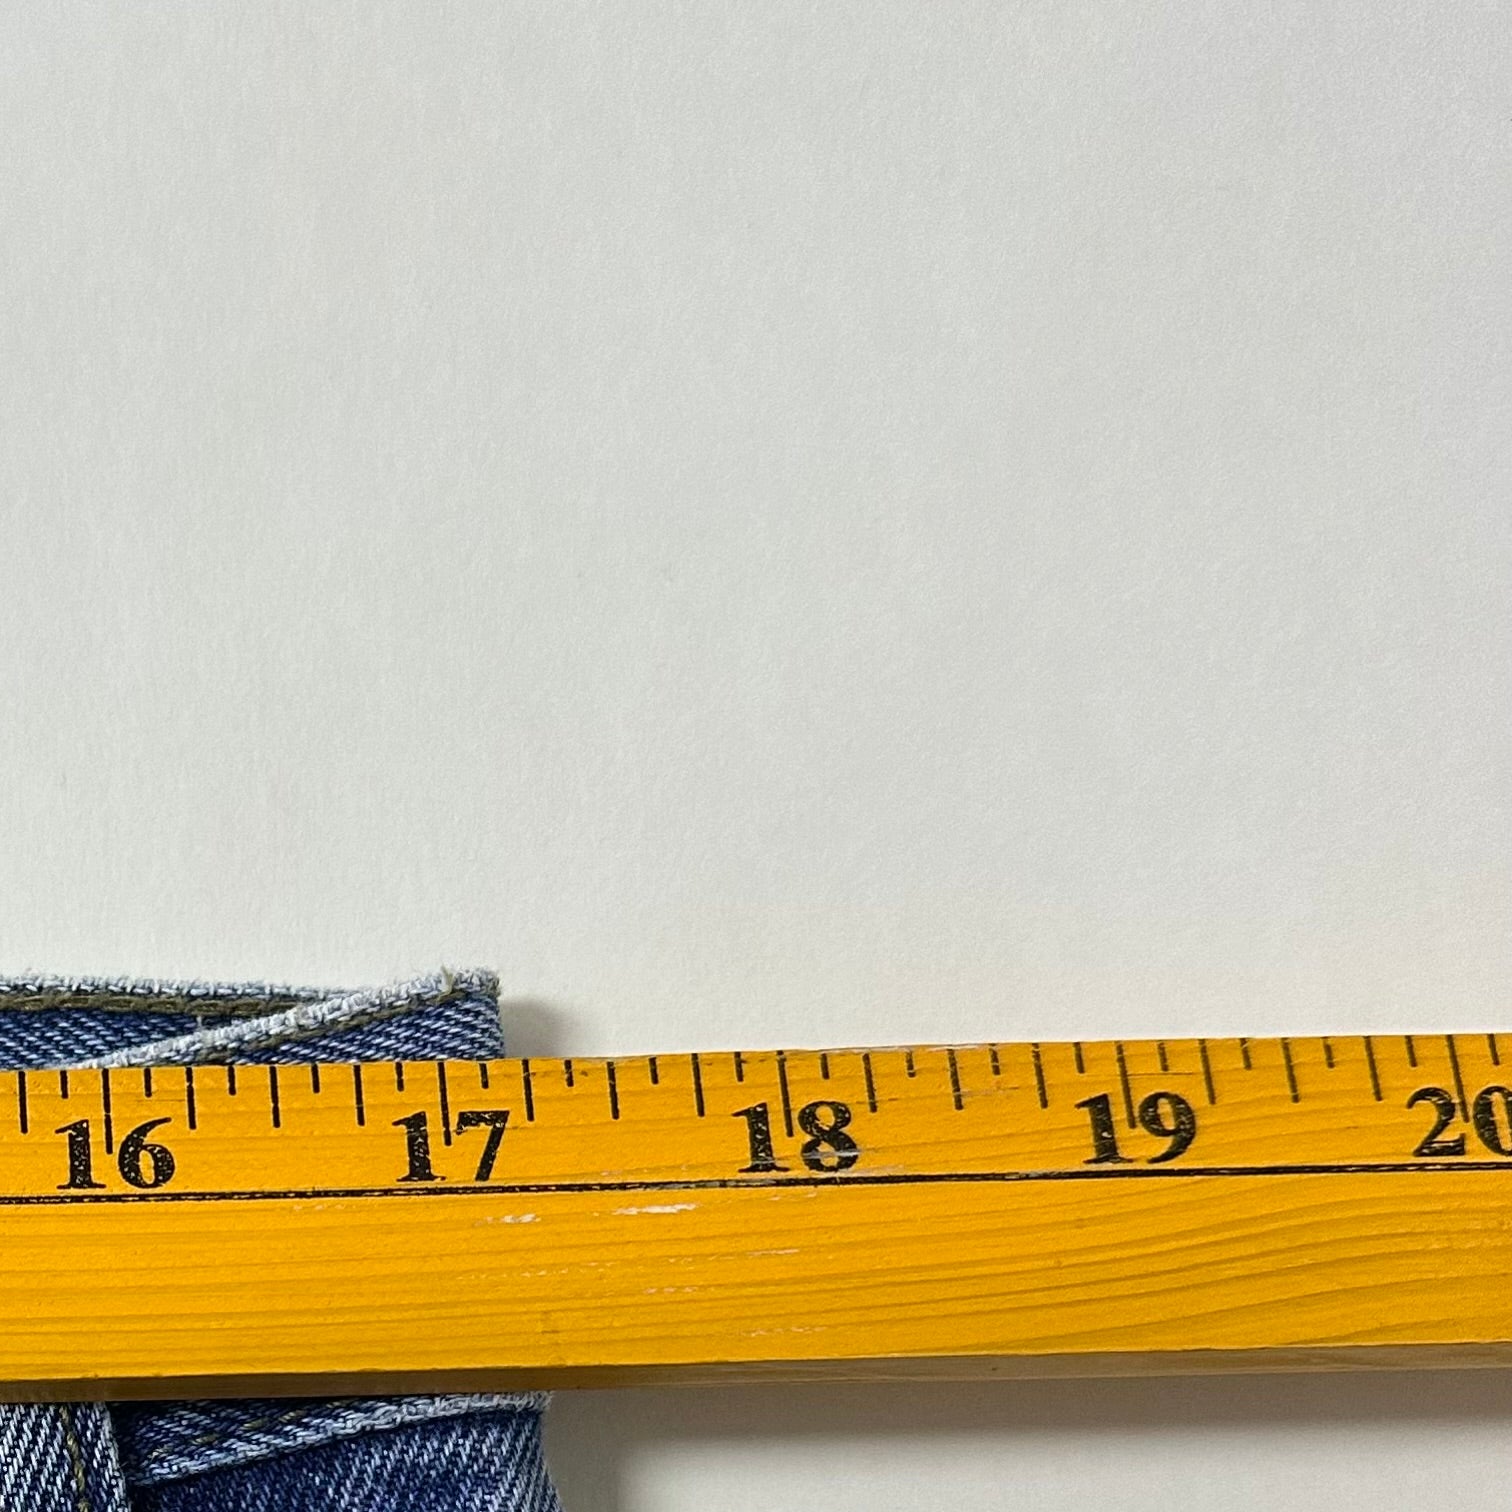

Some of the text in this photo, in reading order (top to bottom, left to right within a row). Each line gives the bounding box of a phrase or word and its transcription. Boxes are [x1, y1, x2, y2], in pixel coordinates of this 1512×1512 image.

[55, 1117, 176, 1189] 16
[392, 1110, 510, 1183] 17
[732, 1101, 859, 1173] 18
[1075, 1091, 1197, 1164] 19
[1406, 1085, 1512, 1157] 20
